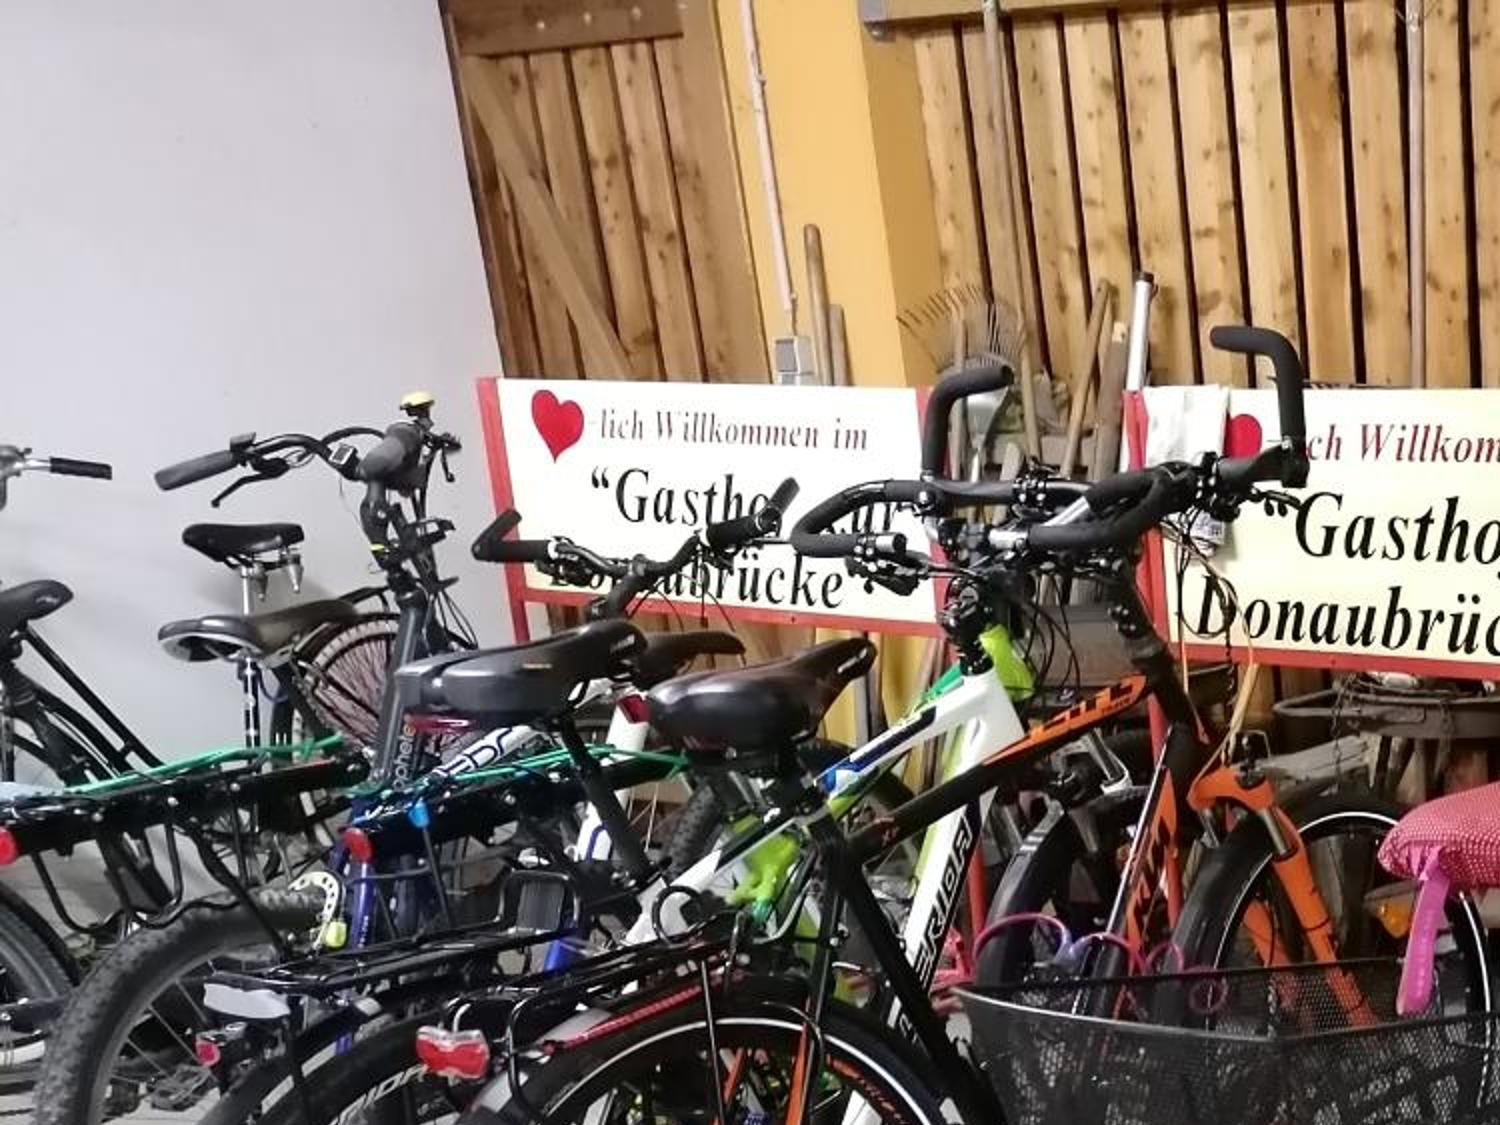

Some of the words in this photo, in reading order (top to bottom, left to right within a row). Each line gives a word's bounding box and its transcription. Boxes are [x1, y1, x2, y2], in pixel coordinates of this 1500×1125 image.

[656, 411, 818, 448] Willkommen
[834, 417, 867, 450] im
[911, 815, 974, 990] ERIDA
